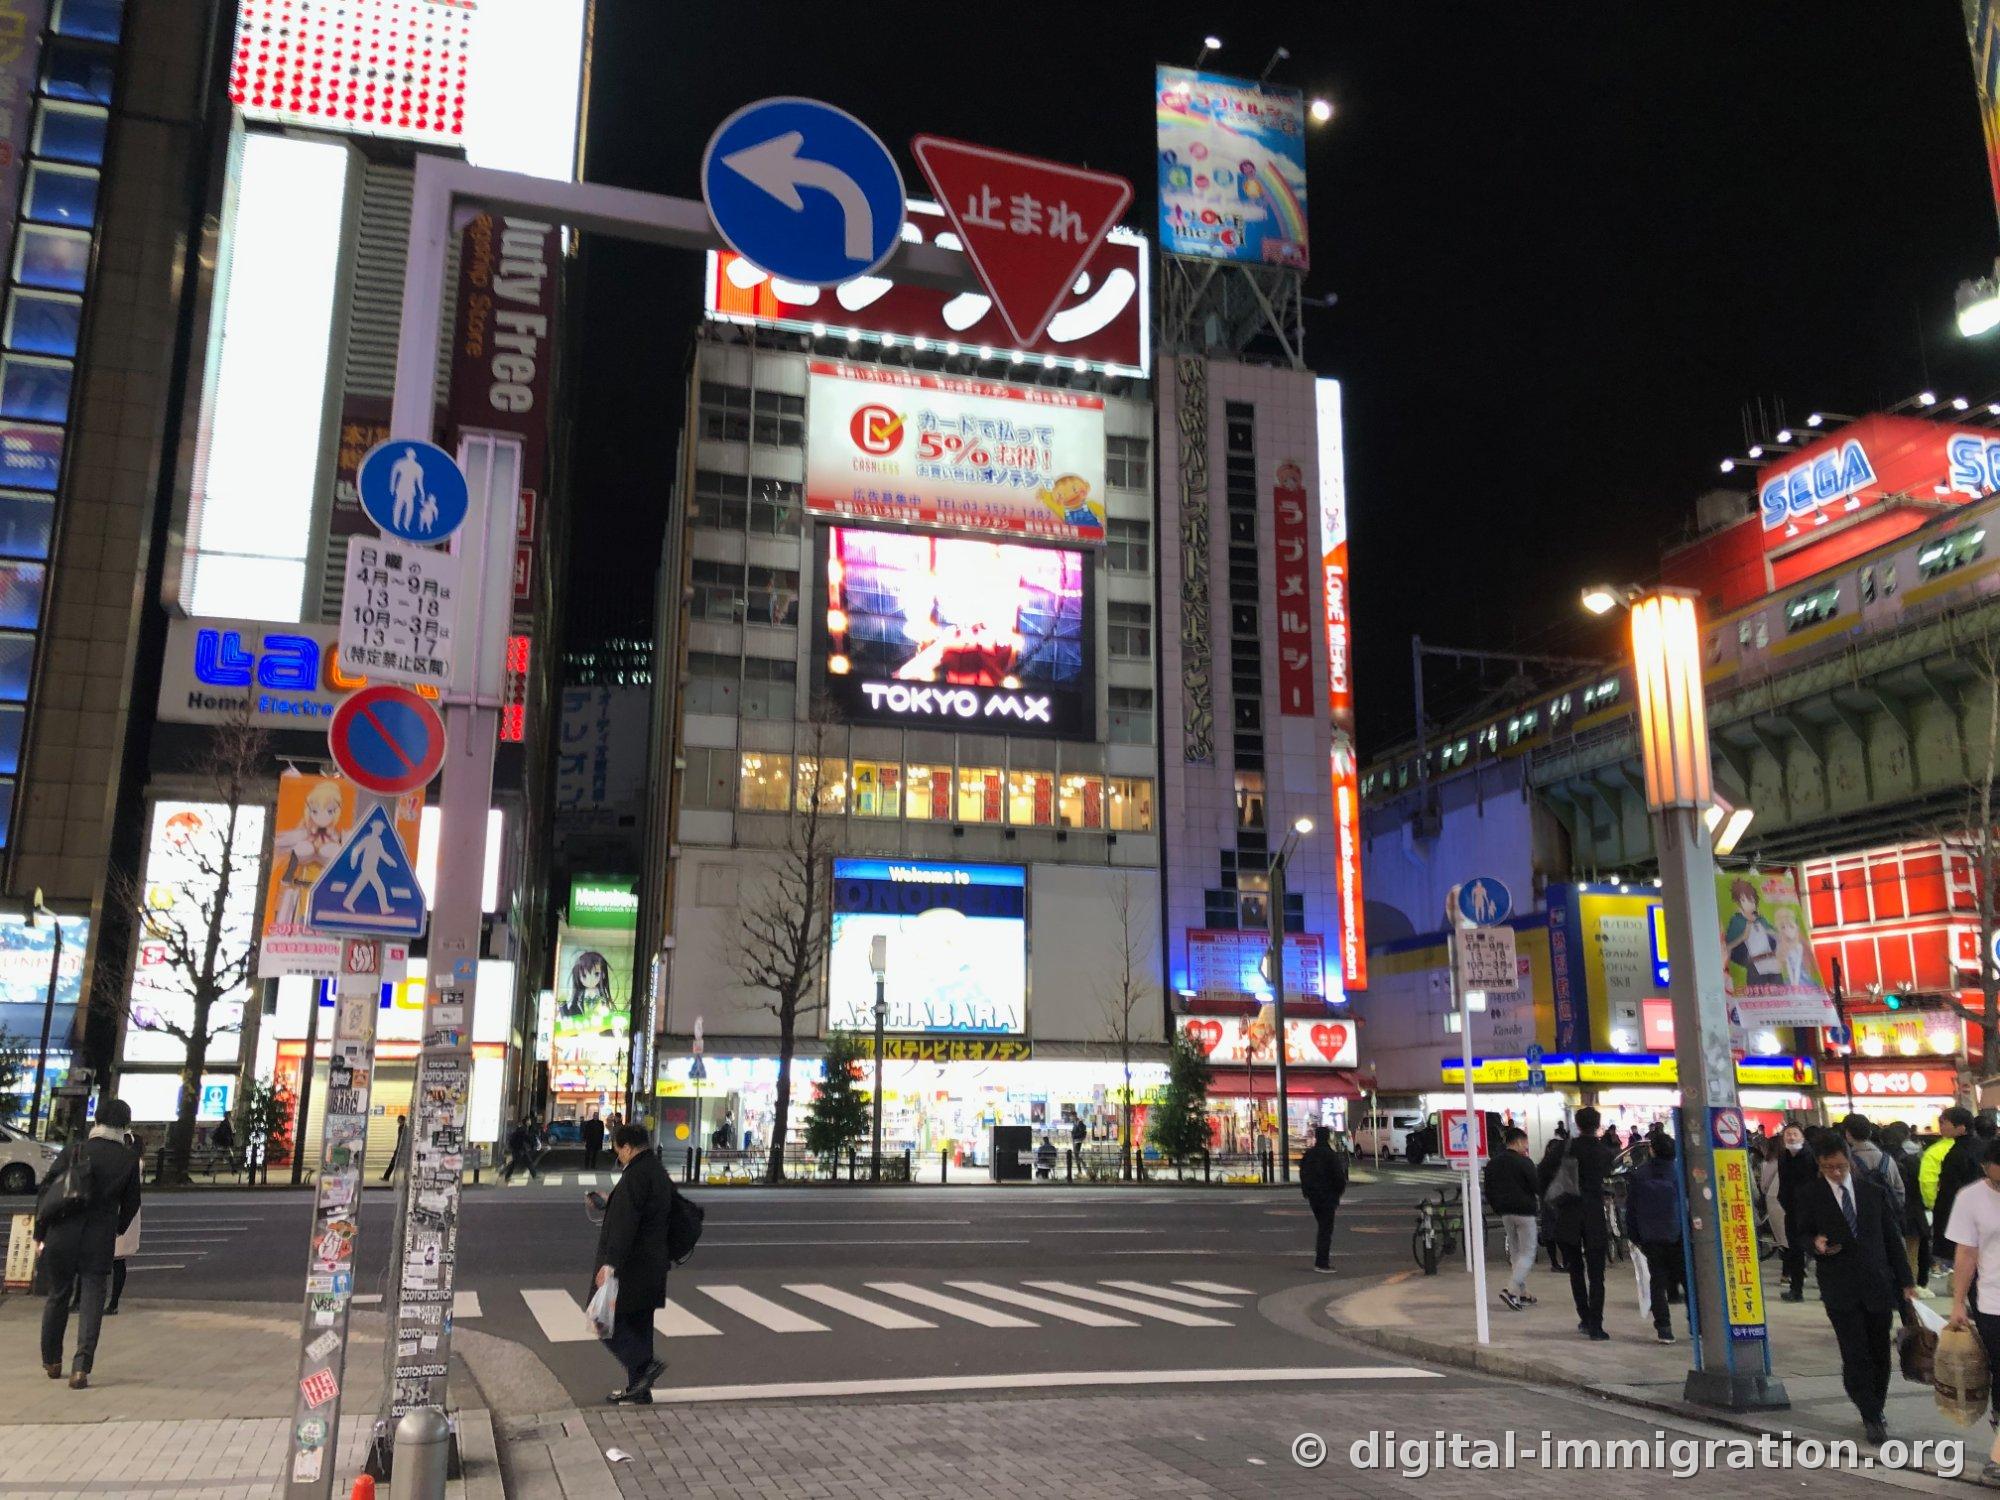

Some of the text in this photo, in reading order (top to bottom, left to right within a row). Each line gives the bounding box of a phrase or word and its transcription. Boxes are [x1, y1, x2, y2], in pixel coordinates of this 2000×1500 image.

[961, 184, 1088, 244] 止まれ
[489, 309, 548, 413] Free
[918, 410, 1054, 445] カードで払って
[1761, 438, 1877, 531] SEGA
[1278, 501, 1309, 702] ラブメルシー
[1325, 565, 1349, 693] LOVE MERCI
[188, 691, 248, 711] Home
[862, 683, 1050, 722] TOKYO MX
[889, 866, 970, 885] Welcome to
[1727, 1162, 1756, 1318] 路上喫煙禁止です。
[402, 1290, 452, 1300] SCOTCH SCOTCH
[396, 1364, 447, 1378] SCOTCH SCOTCH
